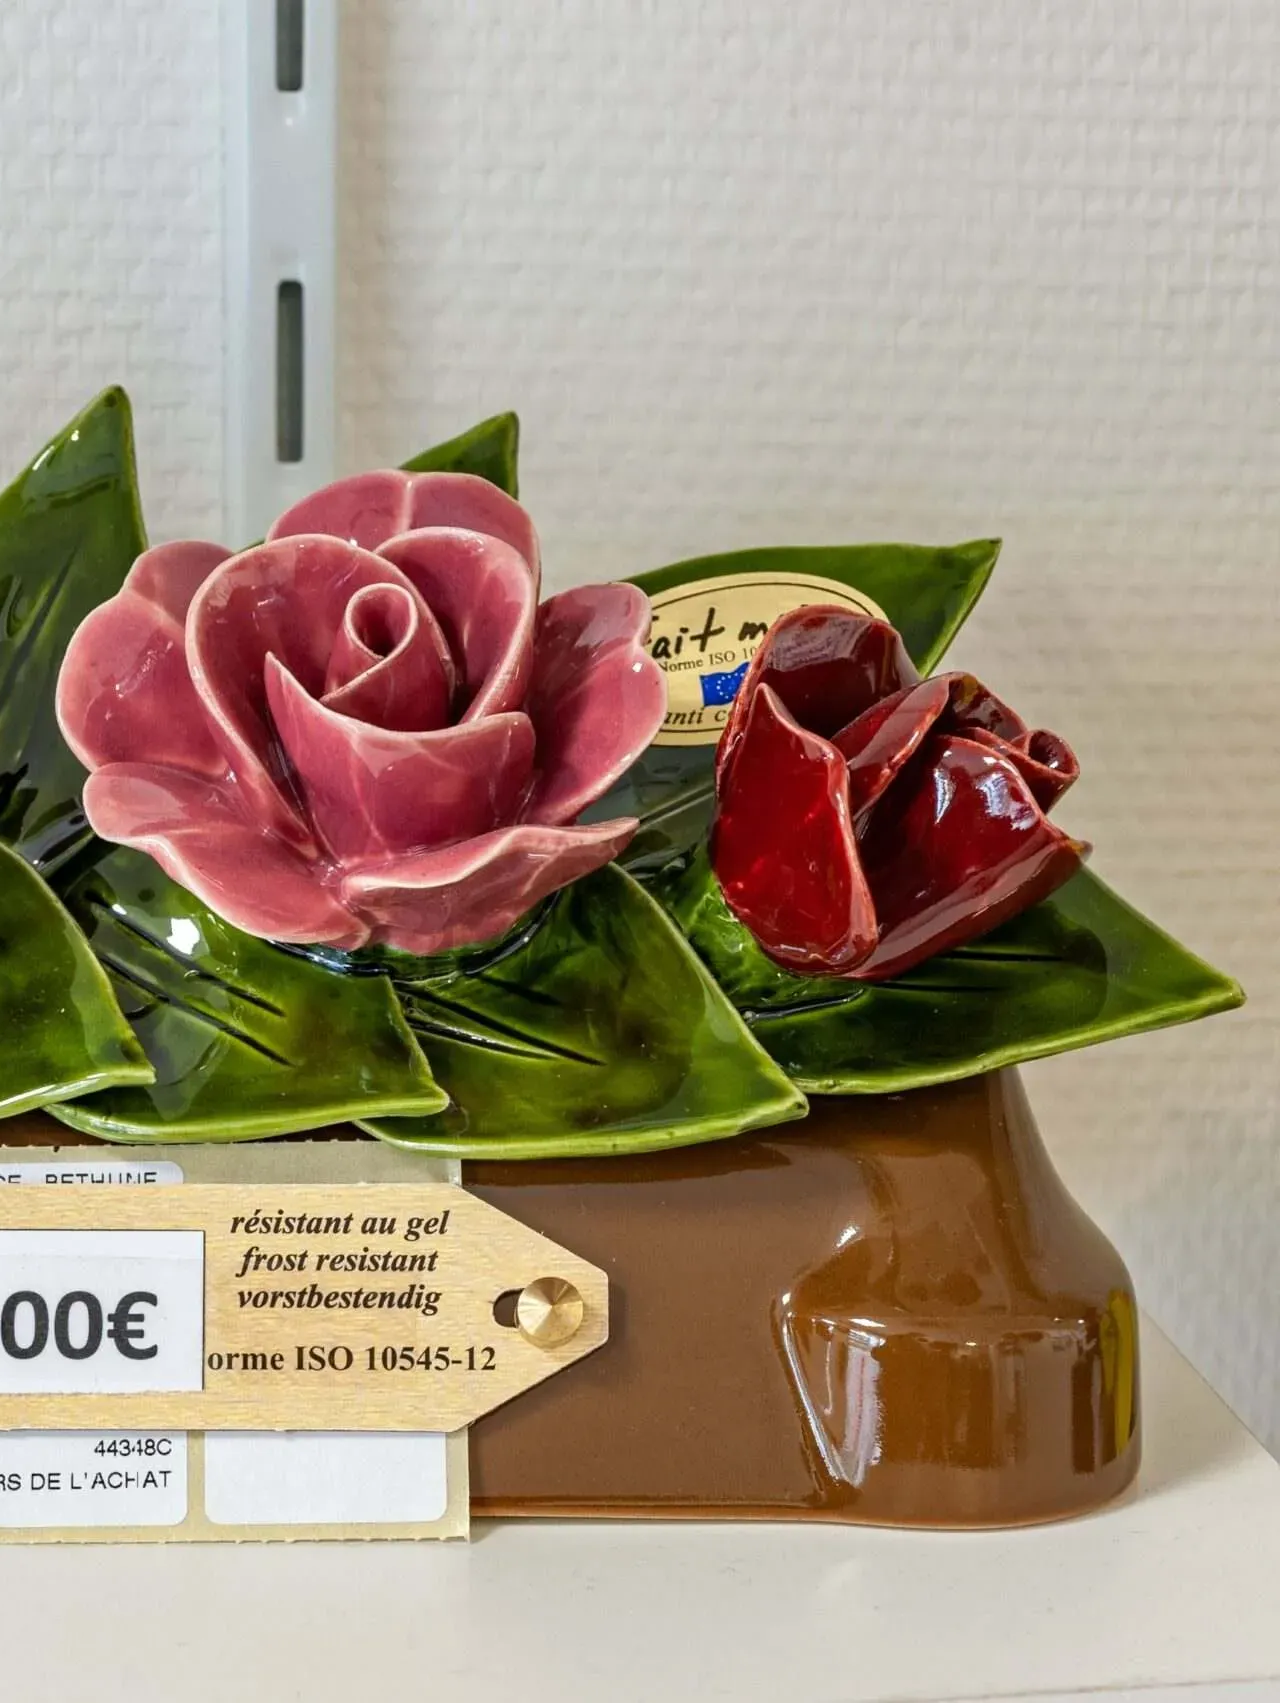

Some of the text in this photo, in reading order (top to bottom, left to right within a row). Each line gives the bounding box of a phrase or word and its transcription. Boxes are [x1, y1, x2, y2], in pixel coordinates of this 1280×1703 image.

[648, 607, 726, 660] ait
[709, 650, 736, 665] ISO
[663, 708, 704, 725] anti
[230, 1208, 450, 1242] résistant au gel
[235, 1246, 439, 1278] frost resistant
[237, 1283, 443, 1317] vorstbestendig
[207, 1345, 496, 1371] orme ISO 10545-12
[30, 1472, 61, 1491] DE
